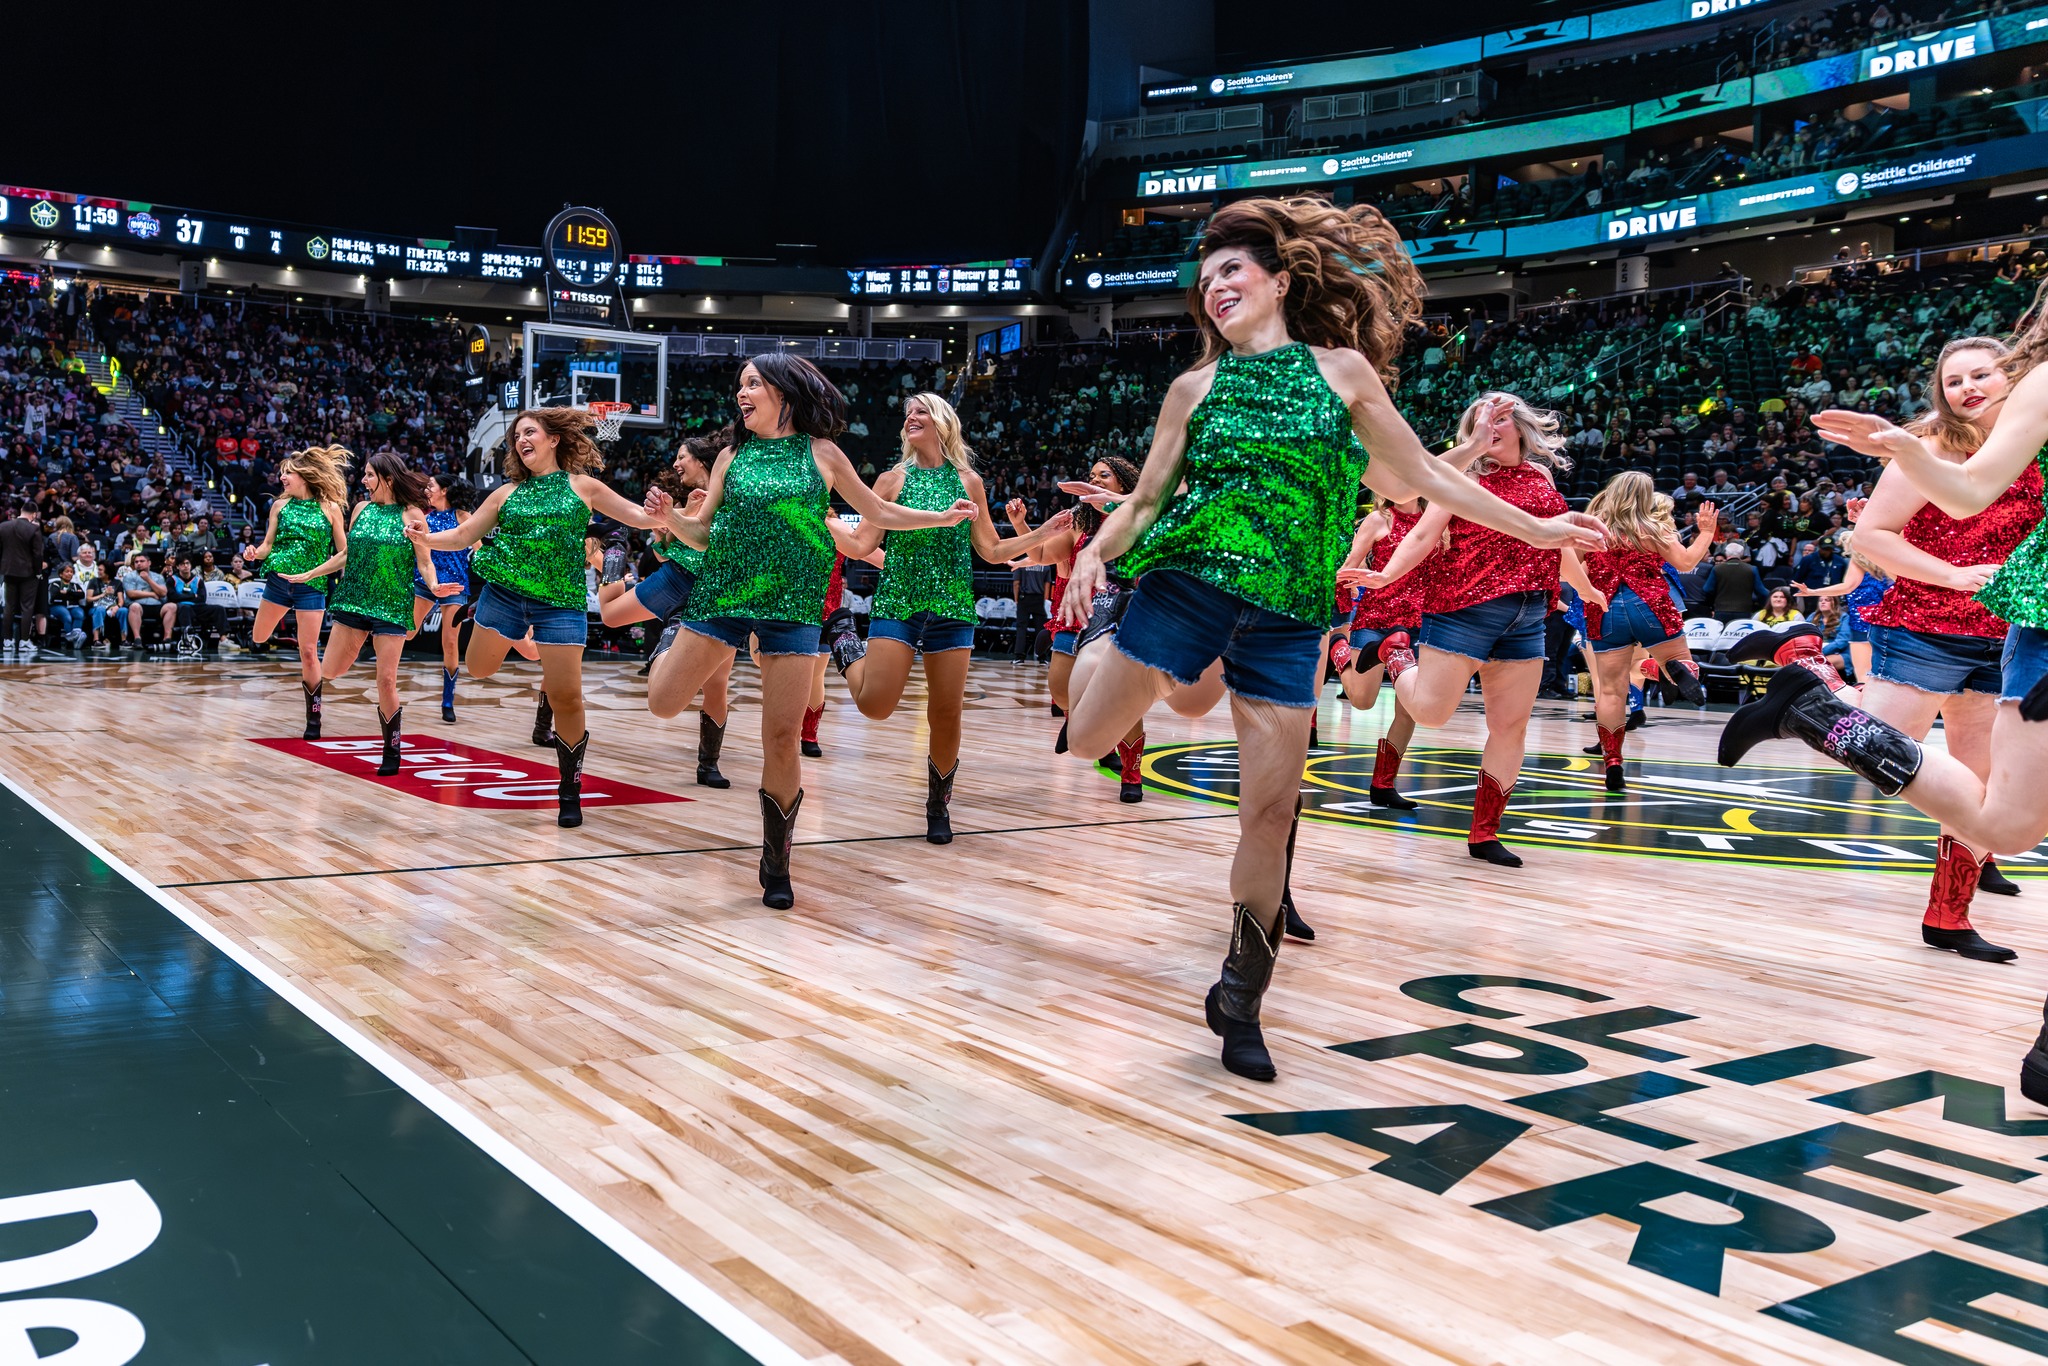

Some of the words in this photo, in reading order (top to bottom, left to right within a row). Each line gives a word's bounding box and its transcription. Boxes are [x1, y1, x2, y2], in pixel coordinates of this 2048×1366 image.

[1870, 34, 1976, 78] DRIVE
[1227, 77, 1254, 86] Seattle
[1148, 86, 1198, 97] BENEFITING
[1341, 157, 1371, 168] Seattle
[1861, 166, 1907, 184] Seattle
[1907, 154, 1974, 176] Children's
[1250, 166, 1307, 177] BENEFITING
[1145, 175, 1217, 195] DRIVE
[1739, 187, 1815, 206] BENEFITING
[73, 204, 118, 225] 11:59
[230, 225, 249, 235] FOULS
[1608, 206, 1697, 240] DRIVE
[177, 218, 203, 244] 37
[567, 224, 607, 247] 11:59
[234, 236, 244, 250] 0
[271, 240, 280, 254] 4
[866, 270, 891, 282] Wings
[901, 270, 911, 281] 91
[953, 269, 986, 281] Mercury
[1105, 273, 1135, 282] Seattle
[1135, 270, 1177, 279] Children's
[866, 282, 892, 294] Liberty
[901, 282, 911, 293] 76
[953, 281, 979, 292] Dream
[570, 293, 612, 305] TISSOT
[1823, 709, 1869, 751] Babes
[307, 741, 612, 799] BECU
